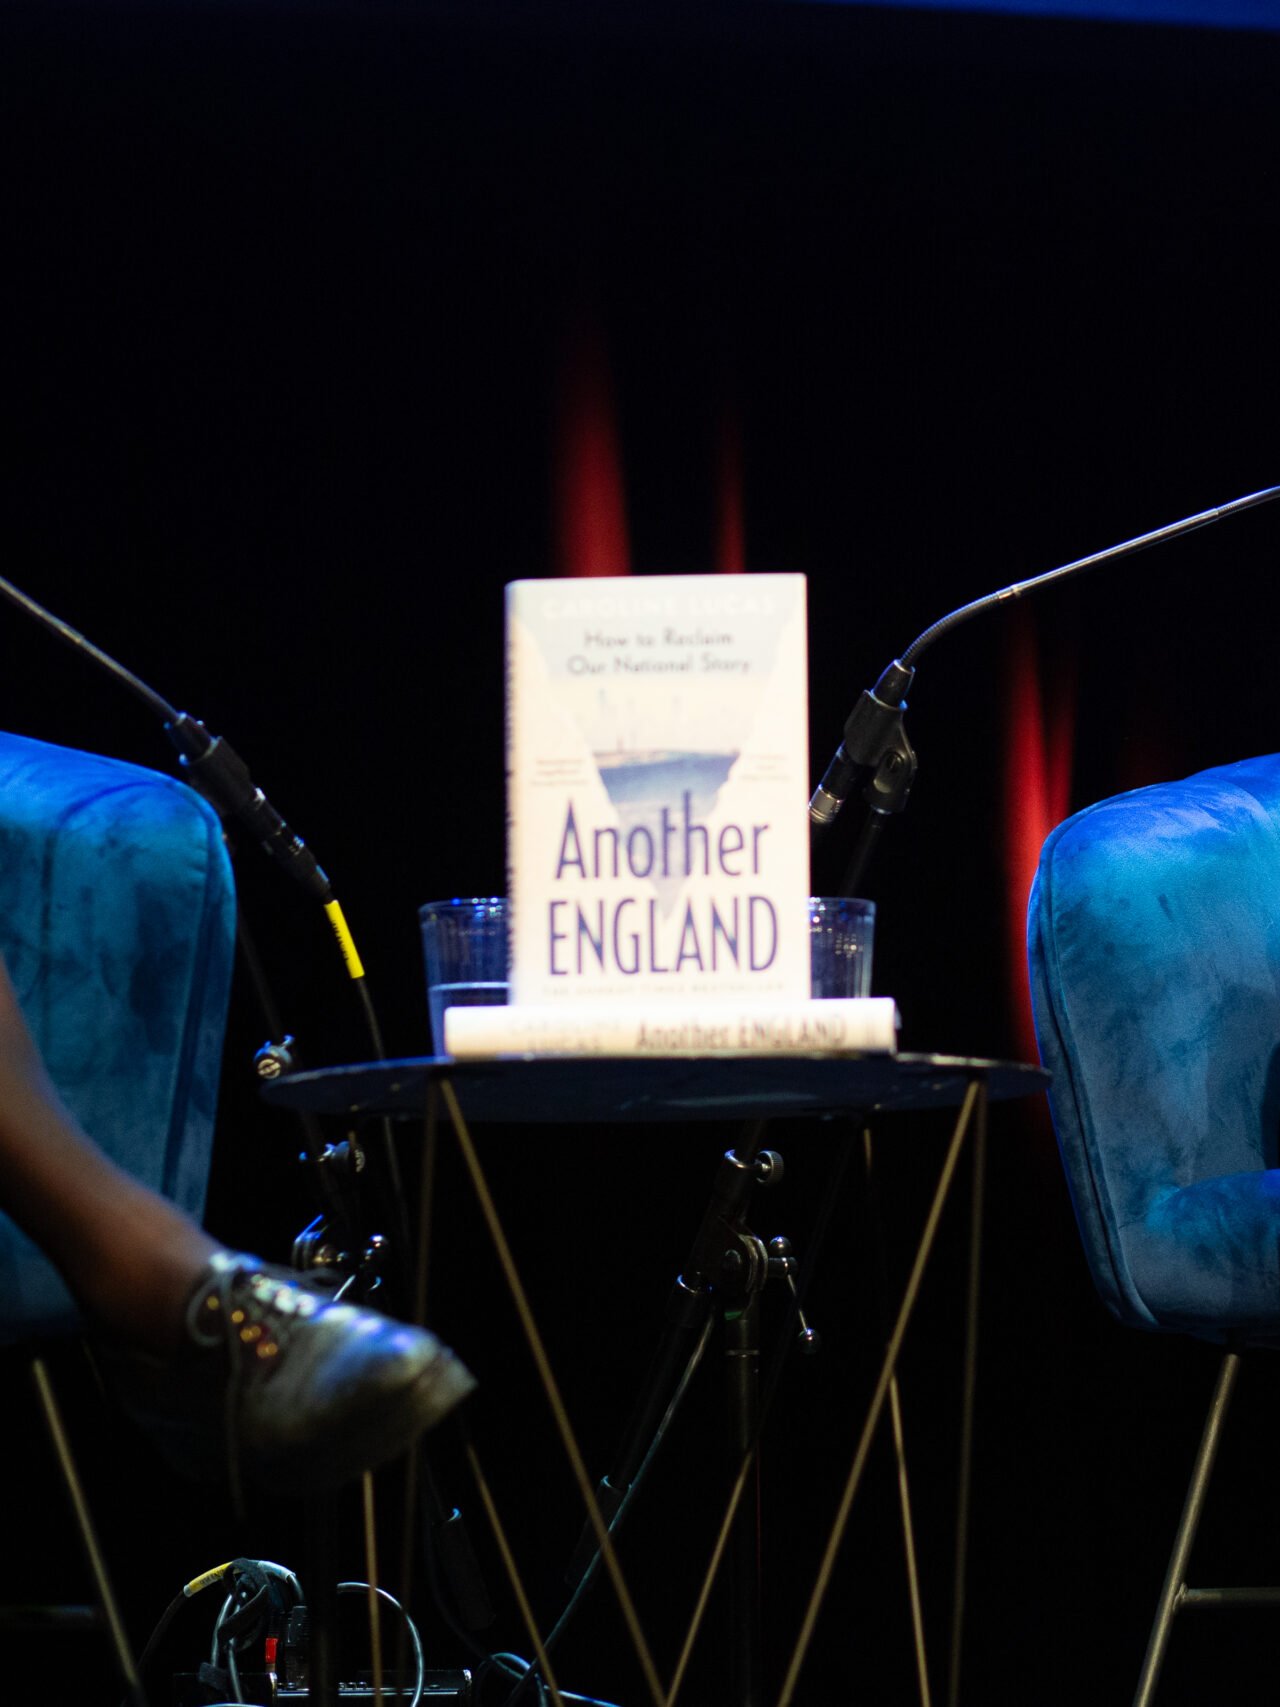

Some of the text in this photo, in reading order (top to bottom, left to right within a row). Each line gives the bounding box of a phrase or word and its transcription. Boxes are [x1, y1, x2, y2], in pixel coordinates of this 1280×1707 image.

[688, 593, 777, 617] LUCAS
[584, 626, 734, 648] How to Reclaim
[566, 651, 750, 676] Our National Story
[555, 790, 769, 880] Another
[548, 896, 778, 976] ENGLAND
[635, 1017, 729, 1051] Another
[737, 1014, 849, 1050] ENGLAND
